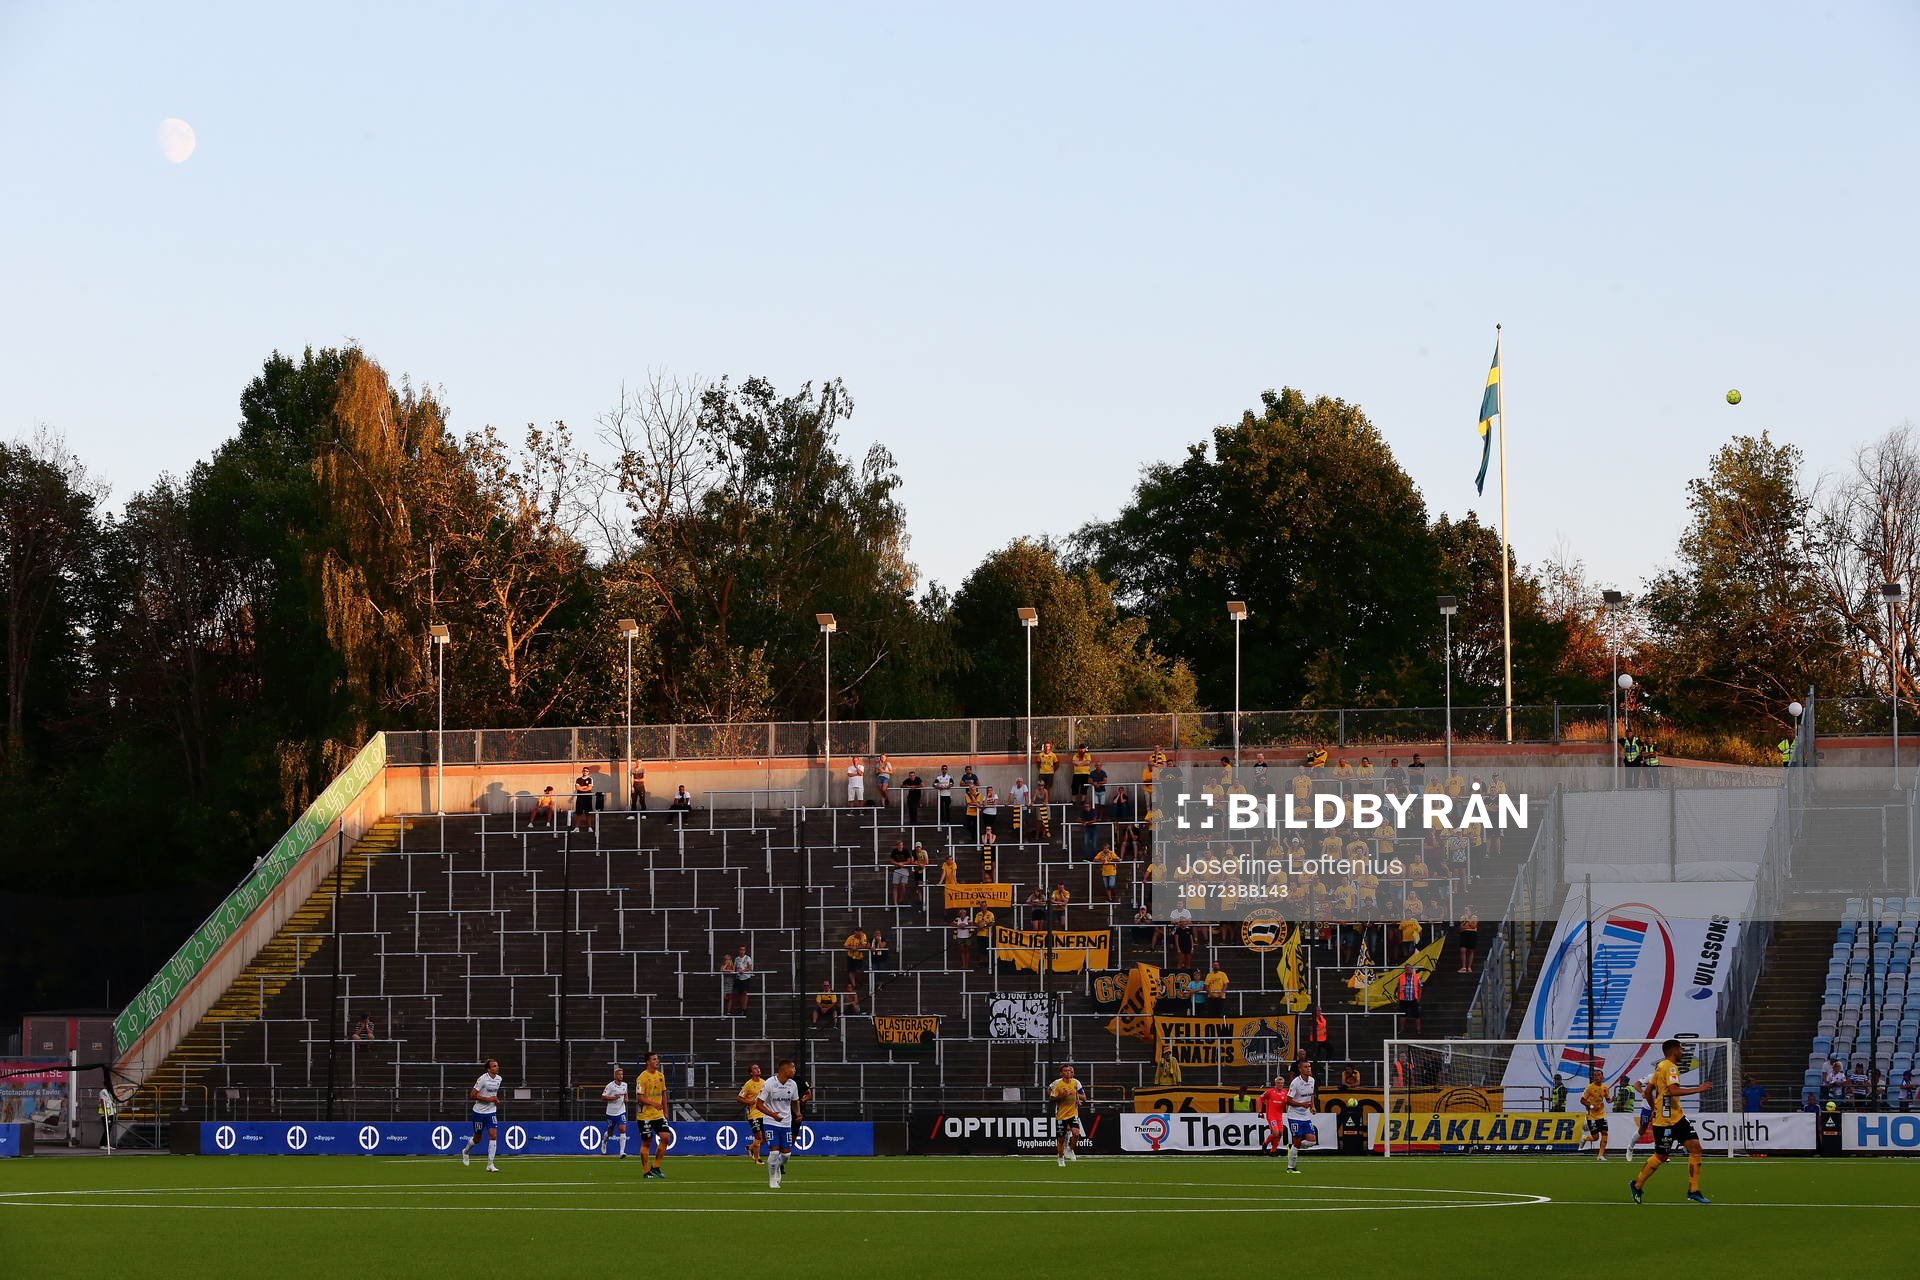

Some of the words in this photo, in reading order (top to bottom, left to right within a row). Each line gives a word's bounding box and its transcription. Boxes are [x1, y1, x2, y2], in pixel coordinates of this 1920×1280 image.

[1007, 992, 1026, 1000] JUNI
[878, 1018, 934, 1031] PLASTGRAS?
[1161, 1022, 1234, 1044] YELLOW
[878, 1031, 894, 1042] NEJ
[897, 1031, 919, 1043] TACK
[1162, 1045, 1235, 1063] ANATICS
[1380, 1114, 1577, 1141] BLÅKLÄDER
[1702, 1119, 1769, 1142] Smith
[1857, 1116, 1920, 1148] HO
[1017, 1139, 1058, 1148] Bygghandel
[1073, 1139, 1093, 1147] roffs
